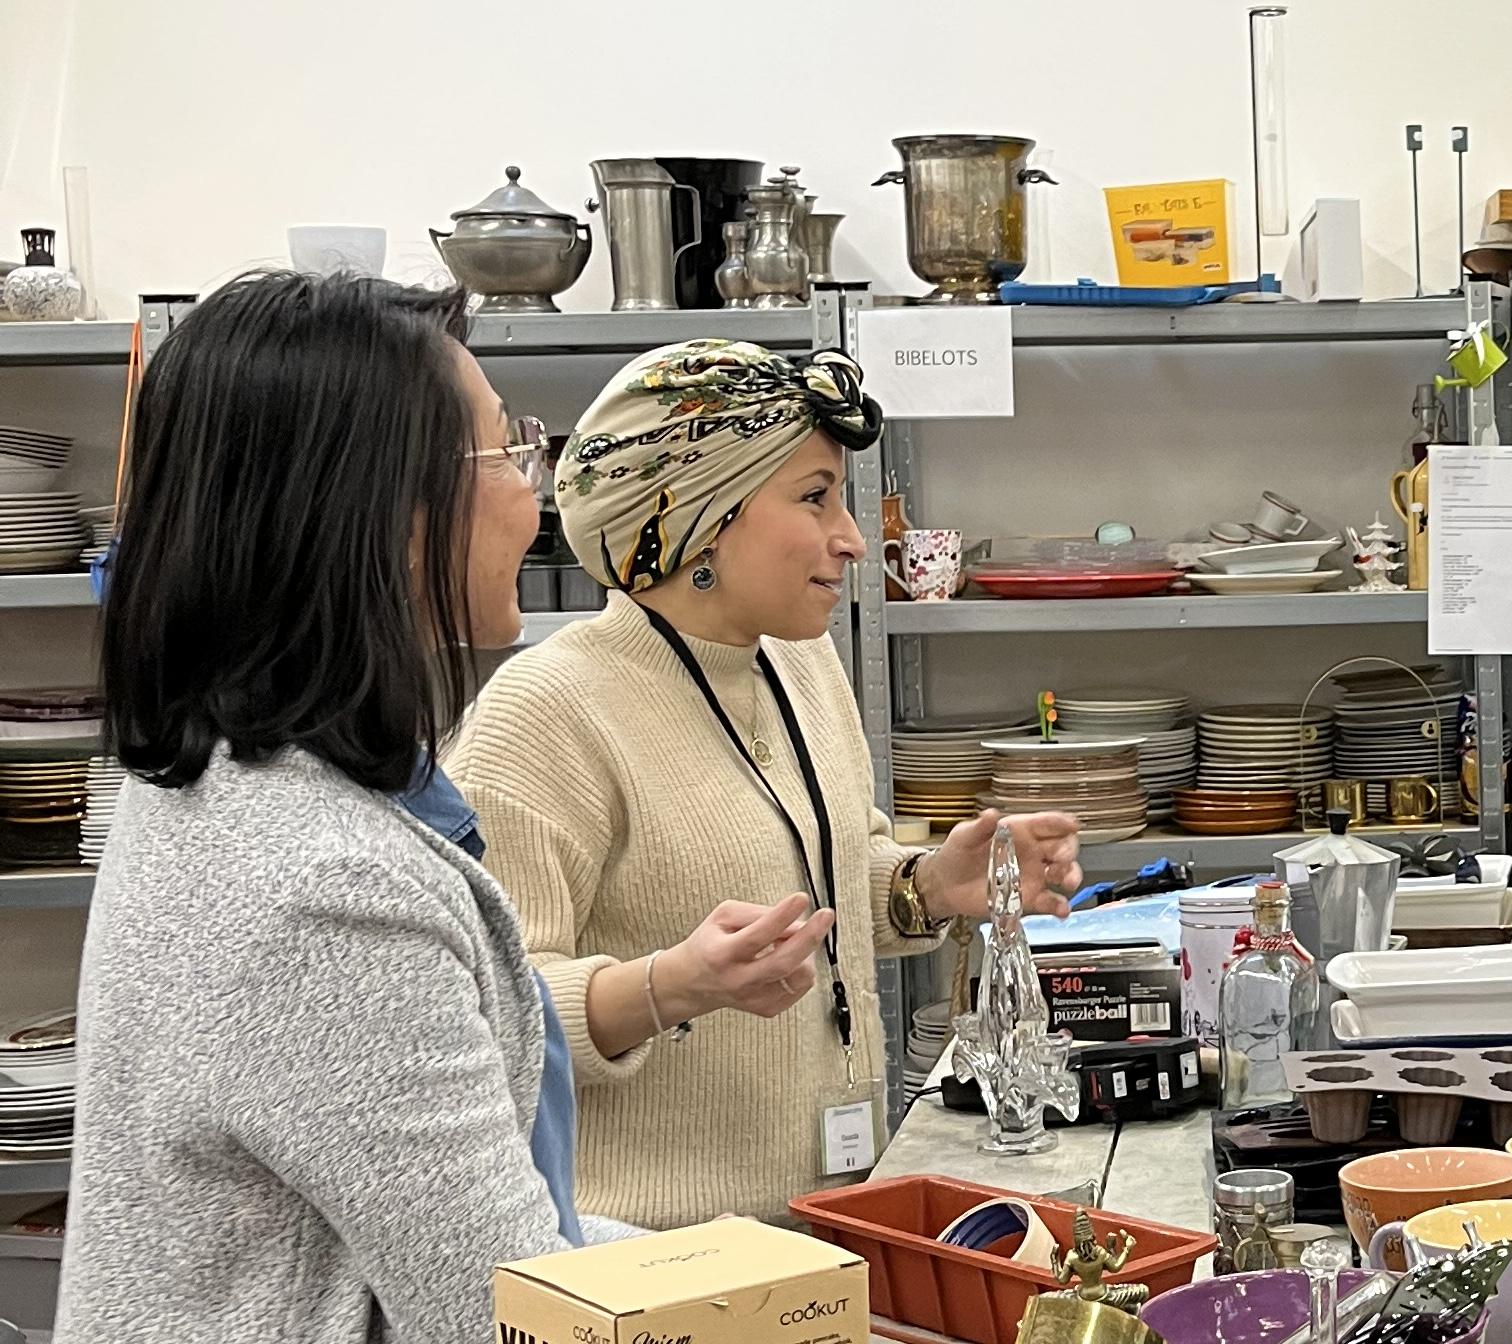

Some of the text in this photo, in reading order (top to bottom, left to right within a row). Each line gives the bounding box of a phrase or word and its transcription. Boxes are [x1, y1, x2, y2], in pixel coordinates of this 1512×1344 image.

[893, 348, 978, 368] BIBELOTS
[1052, 976, 1083, 994] 540
[1052, 996, 1102, 1006] Ravensburger
[1054, 1004, 1128, 1025] puzzleball
[779, 1297, 850, 1326] COOKUT
